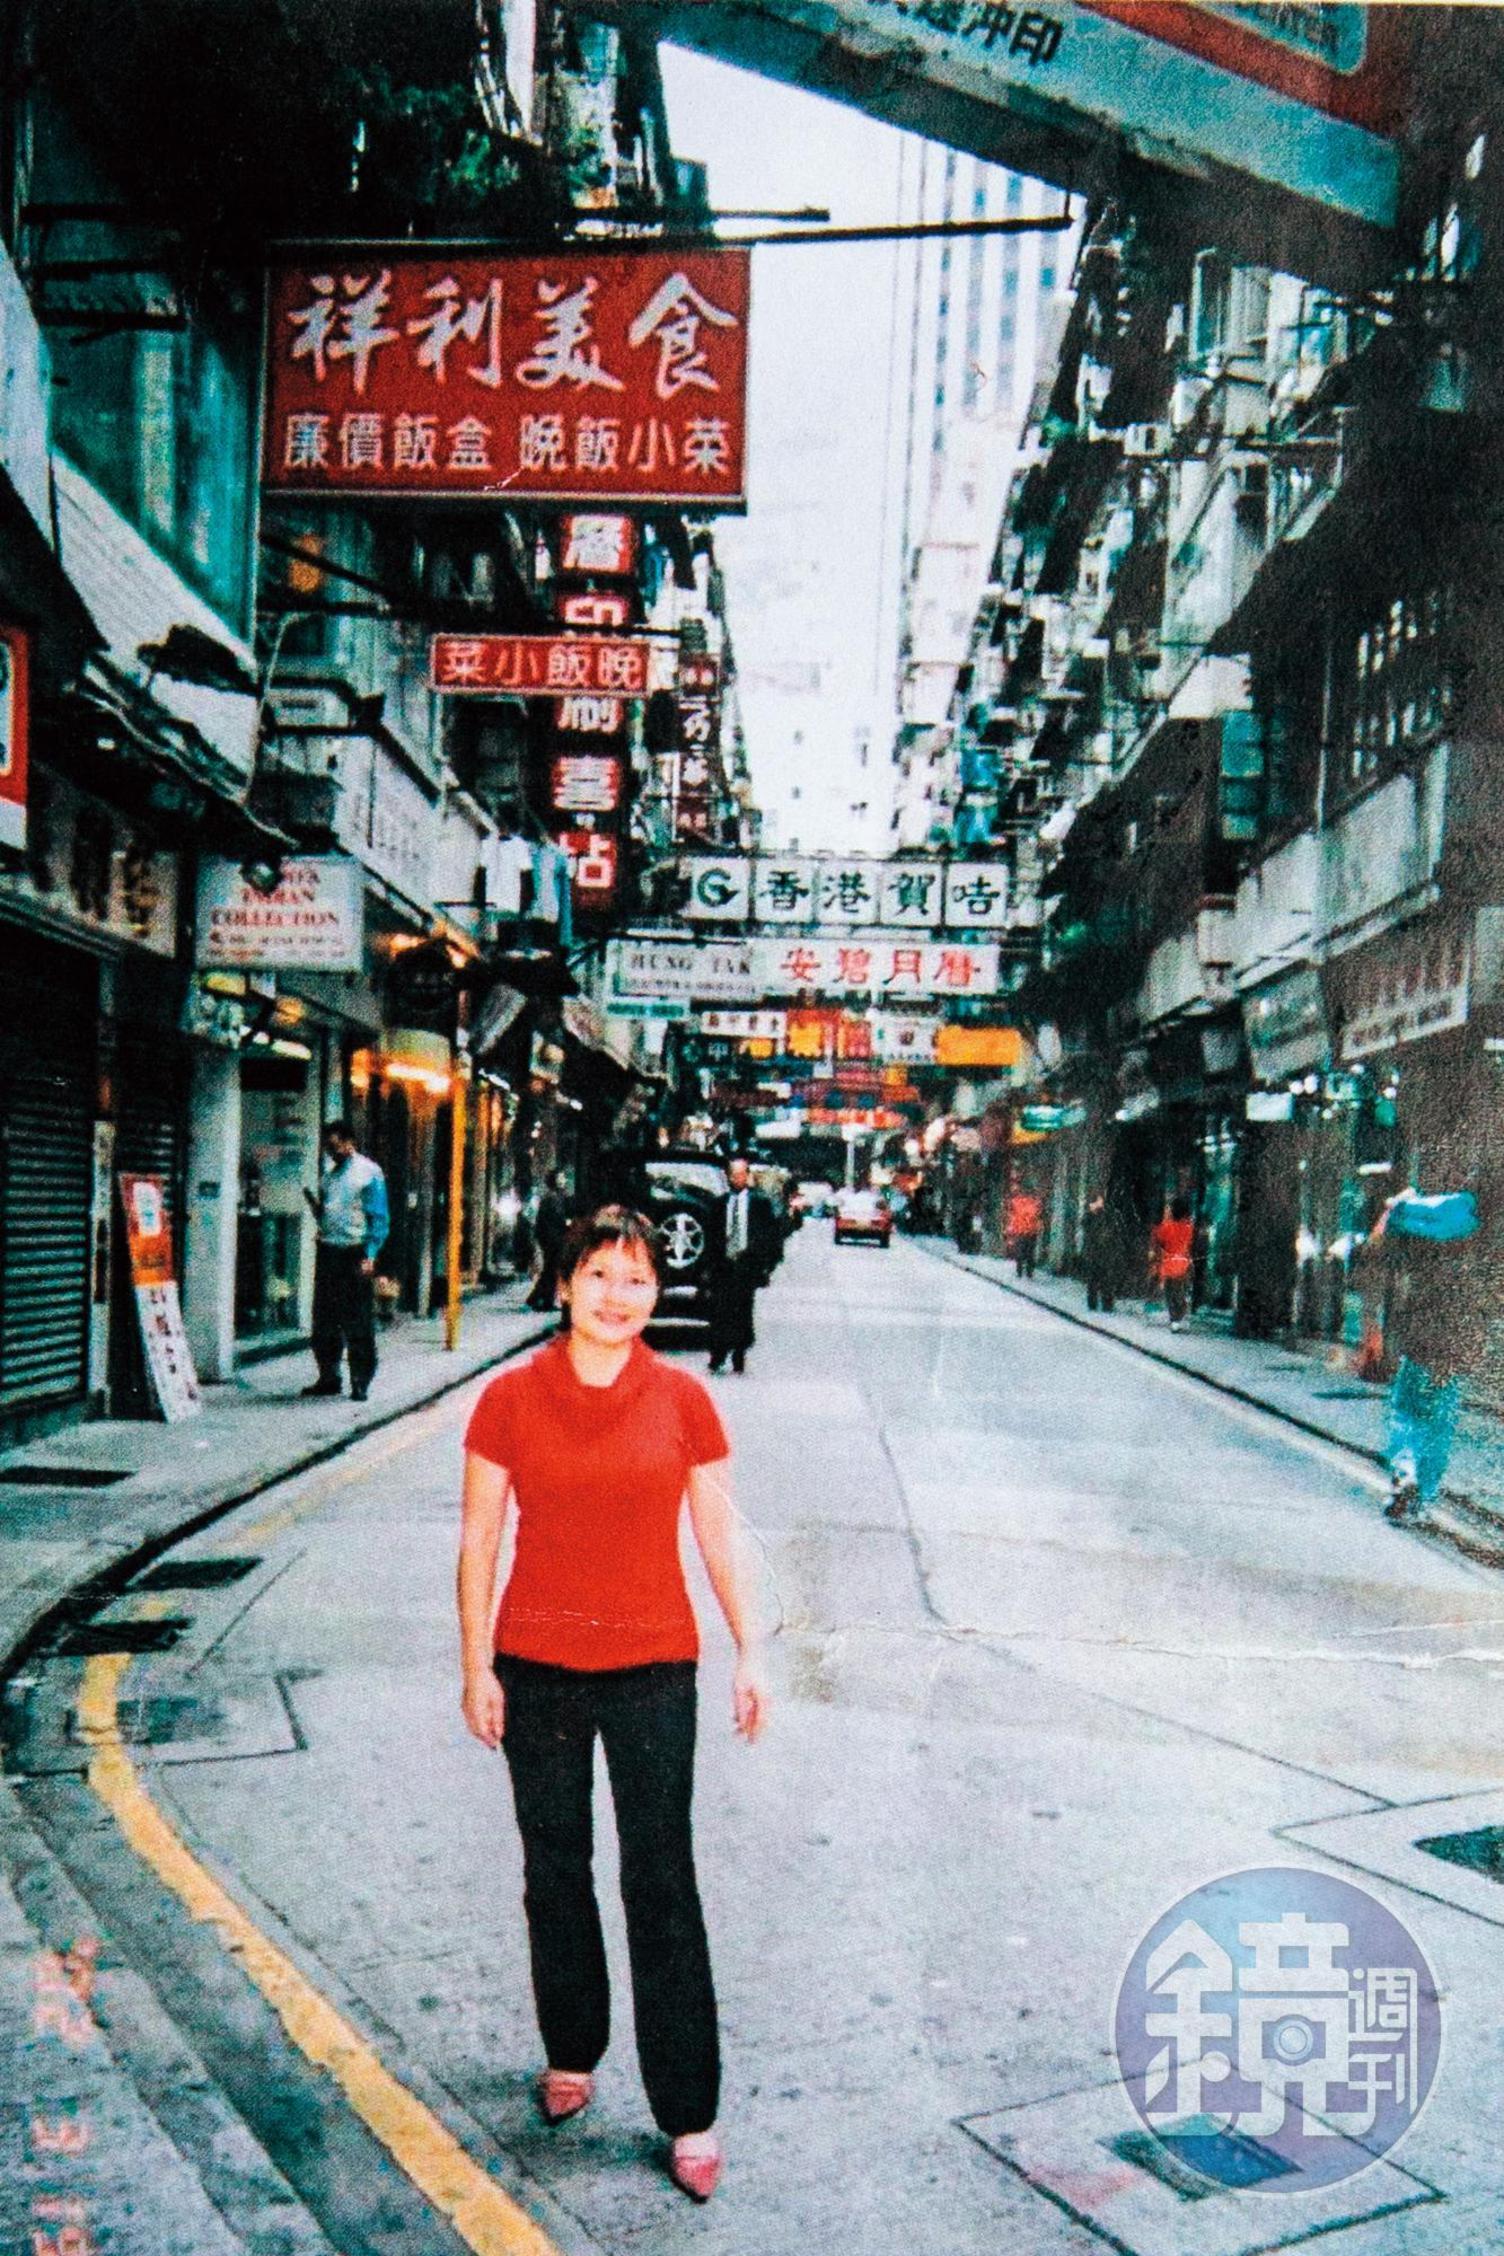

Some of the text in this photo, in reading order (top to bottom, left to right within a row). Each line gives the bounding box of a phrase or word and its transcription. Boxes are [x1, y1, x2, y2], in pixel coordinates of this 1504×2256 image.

[287, 268, 739, 401] 祥利美食
[283, 411, 731, 474] 廉價飯盒 晚飯小菜
[759, 869, 1000, 917] 香港賀咭
